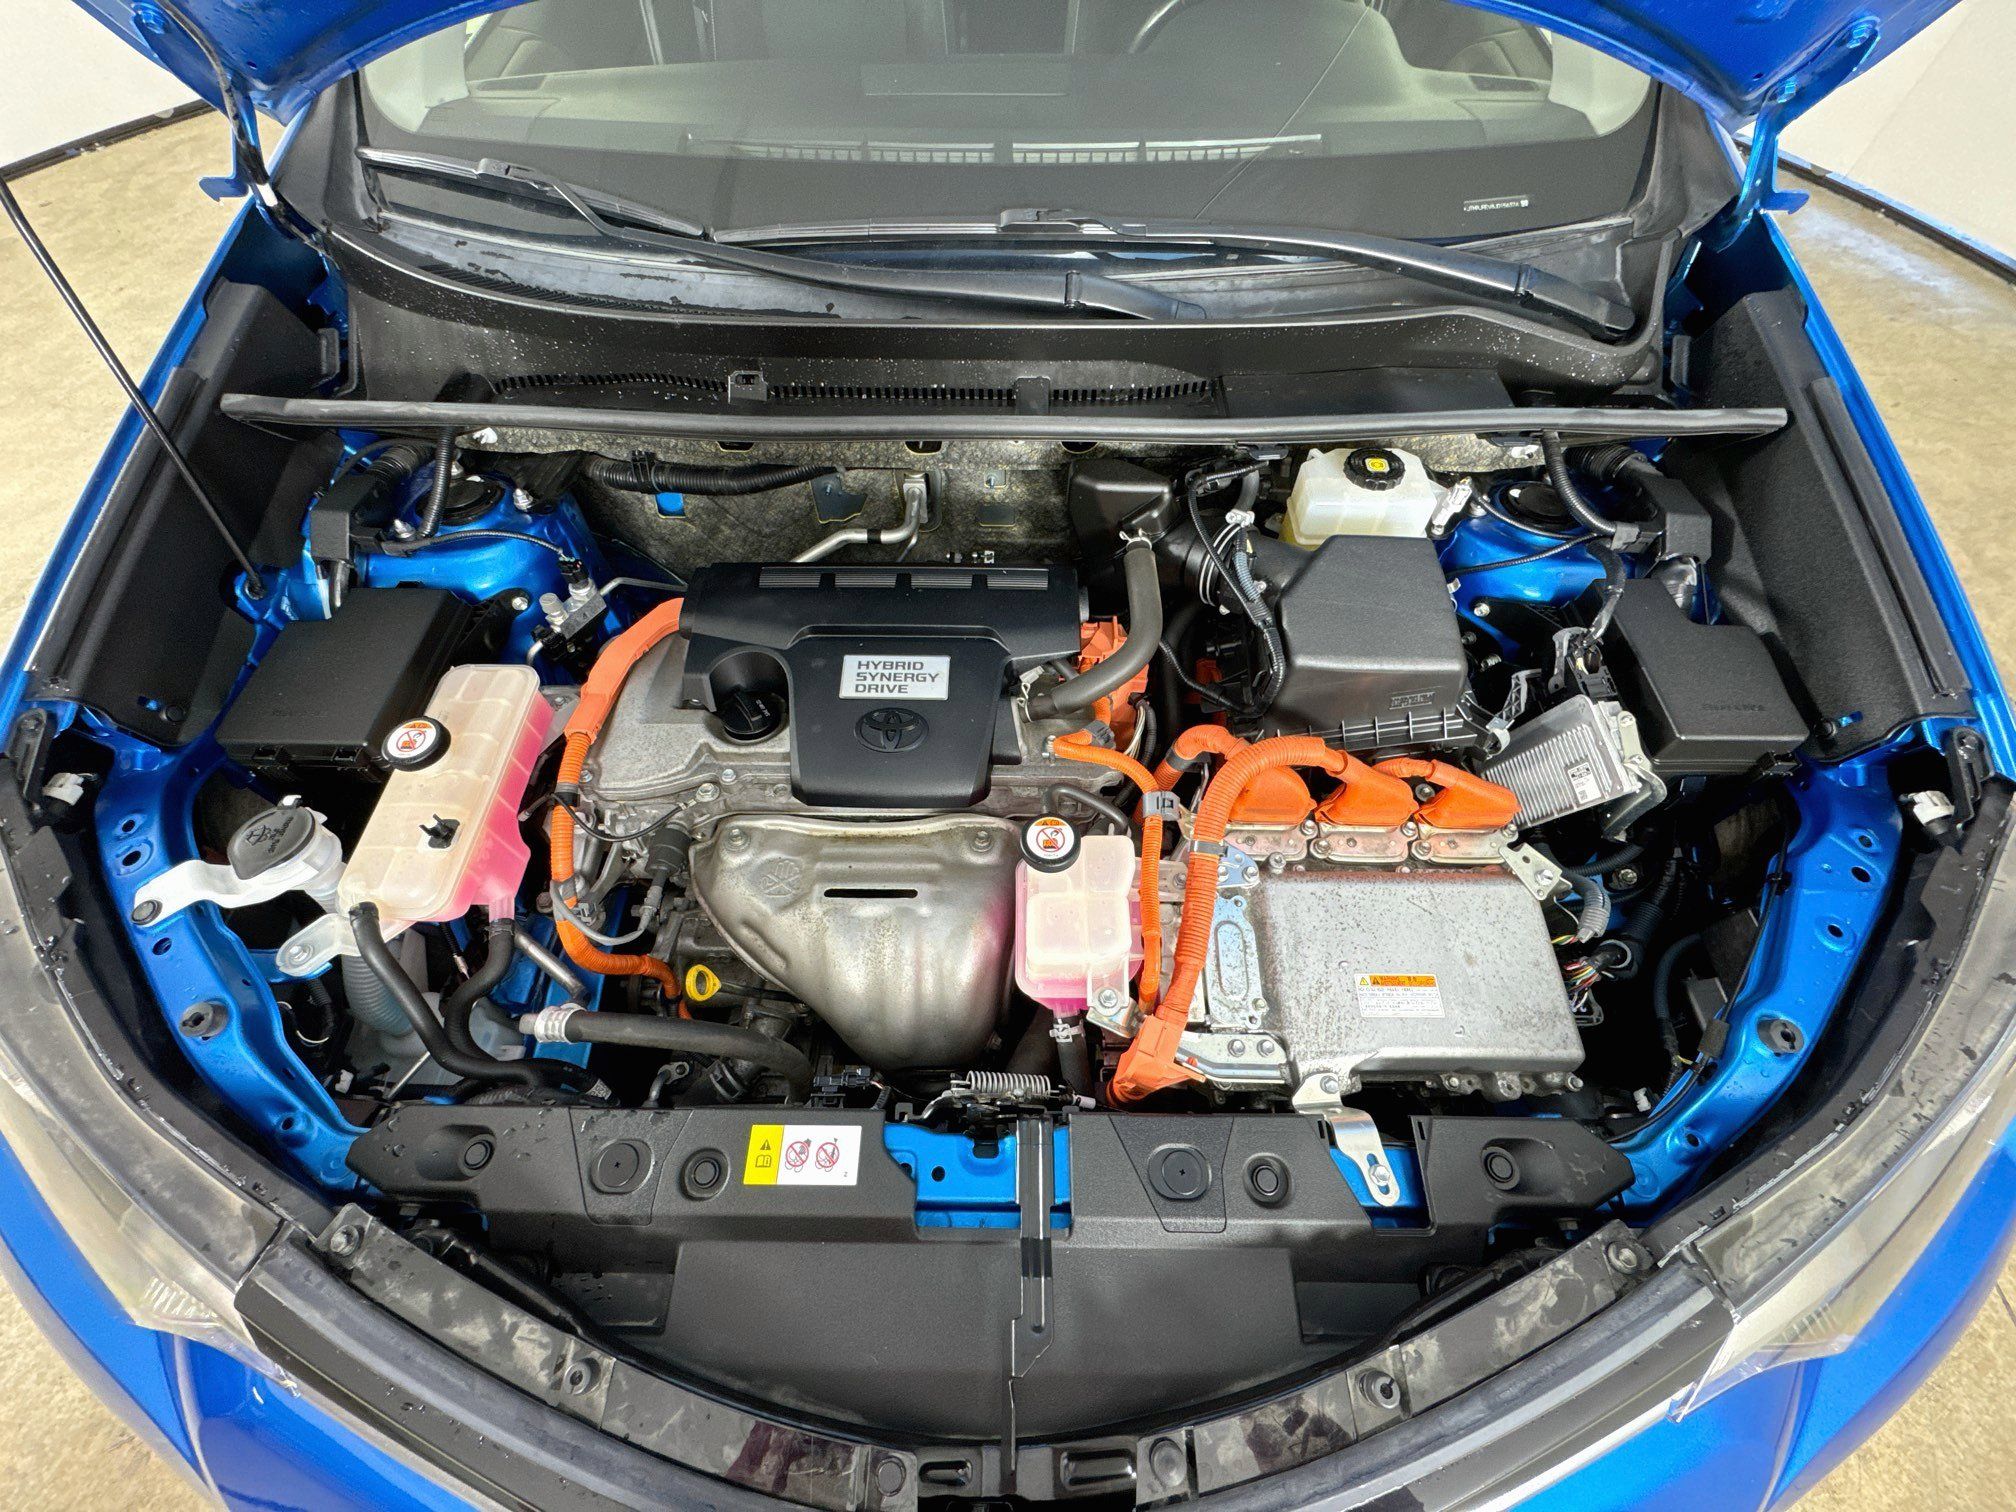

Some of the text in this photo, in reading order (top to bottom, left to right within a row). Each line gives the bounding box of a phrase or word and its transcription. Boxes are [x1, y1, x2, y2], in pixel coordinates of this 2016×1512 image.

[857, 660, 925, 671] HYBRID
[855, 671, 940, 683] SYNERGY
[854, 683, 909, 694] DRIVE
